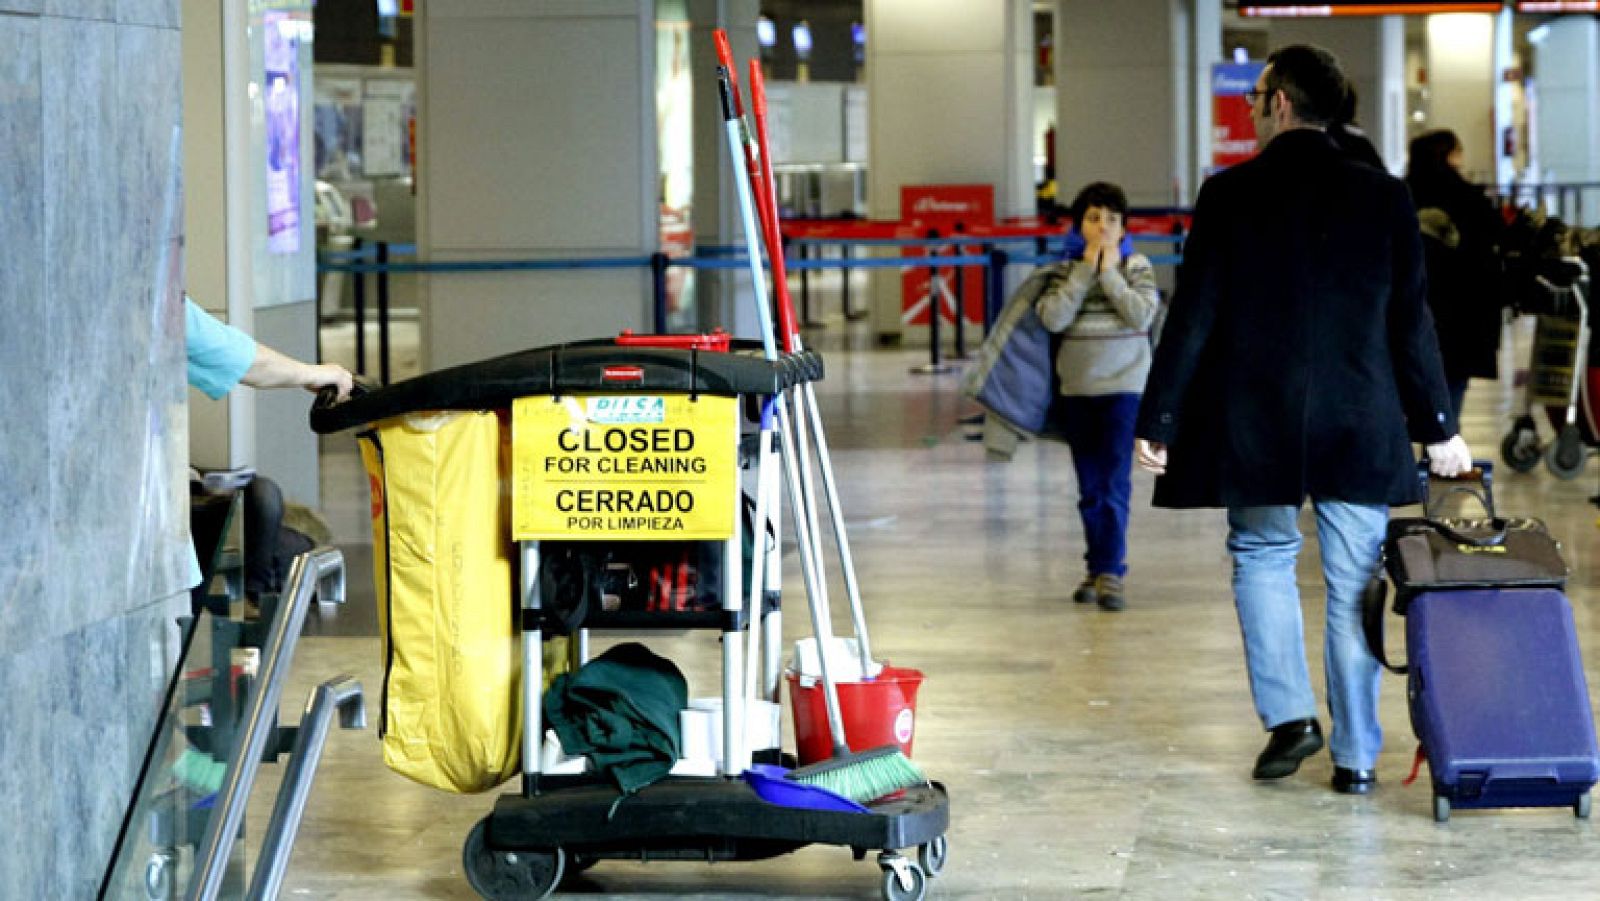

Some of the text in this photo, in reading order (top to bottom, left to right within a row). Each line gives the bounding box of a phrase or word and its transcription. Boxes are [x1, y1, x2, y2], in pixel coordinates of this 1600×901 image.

[557, 428, 695, 453] CLOSED
[544, 456, 707, 474] FOR CLEANING
[555, 489, 695, 514] CERRADO
[567, 516, 684, 530] POR LIMPIEZA
